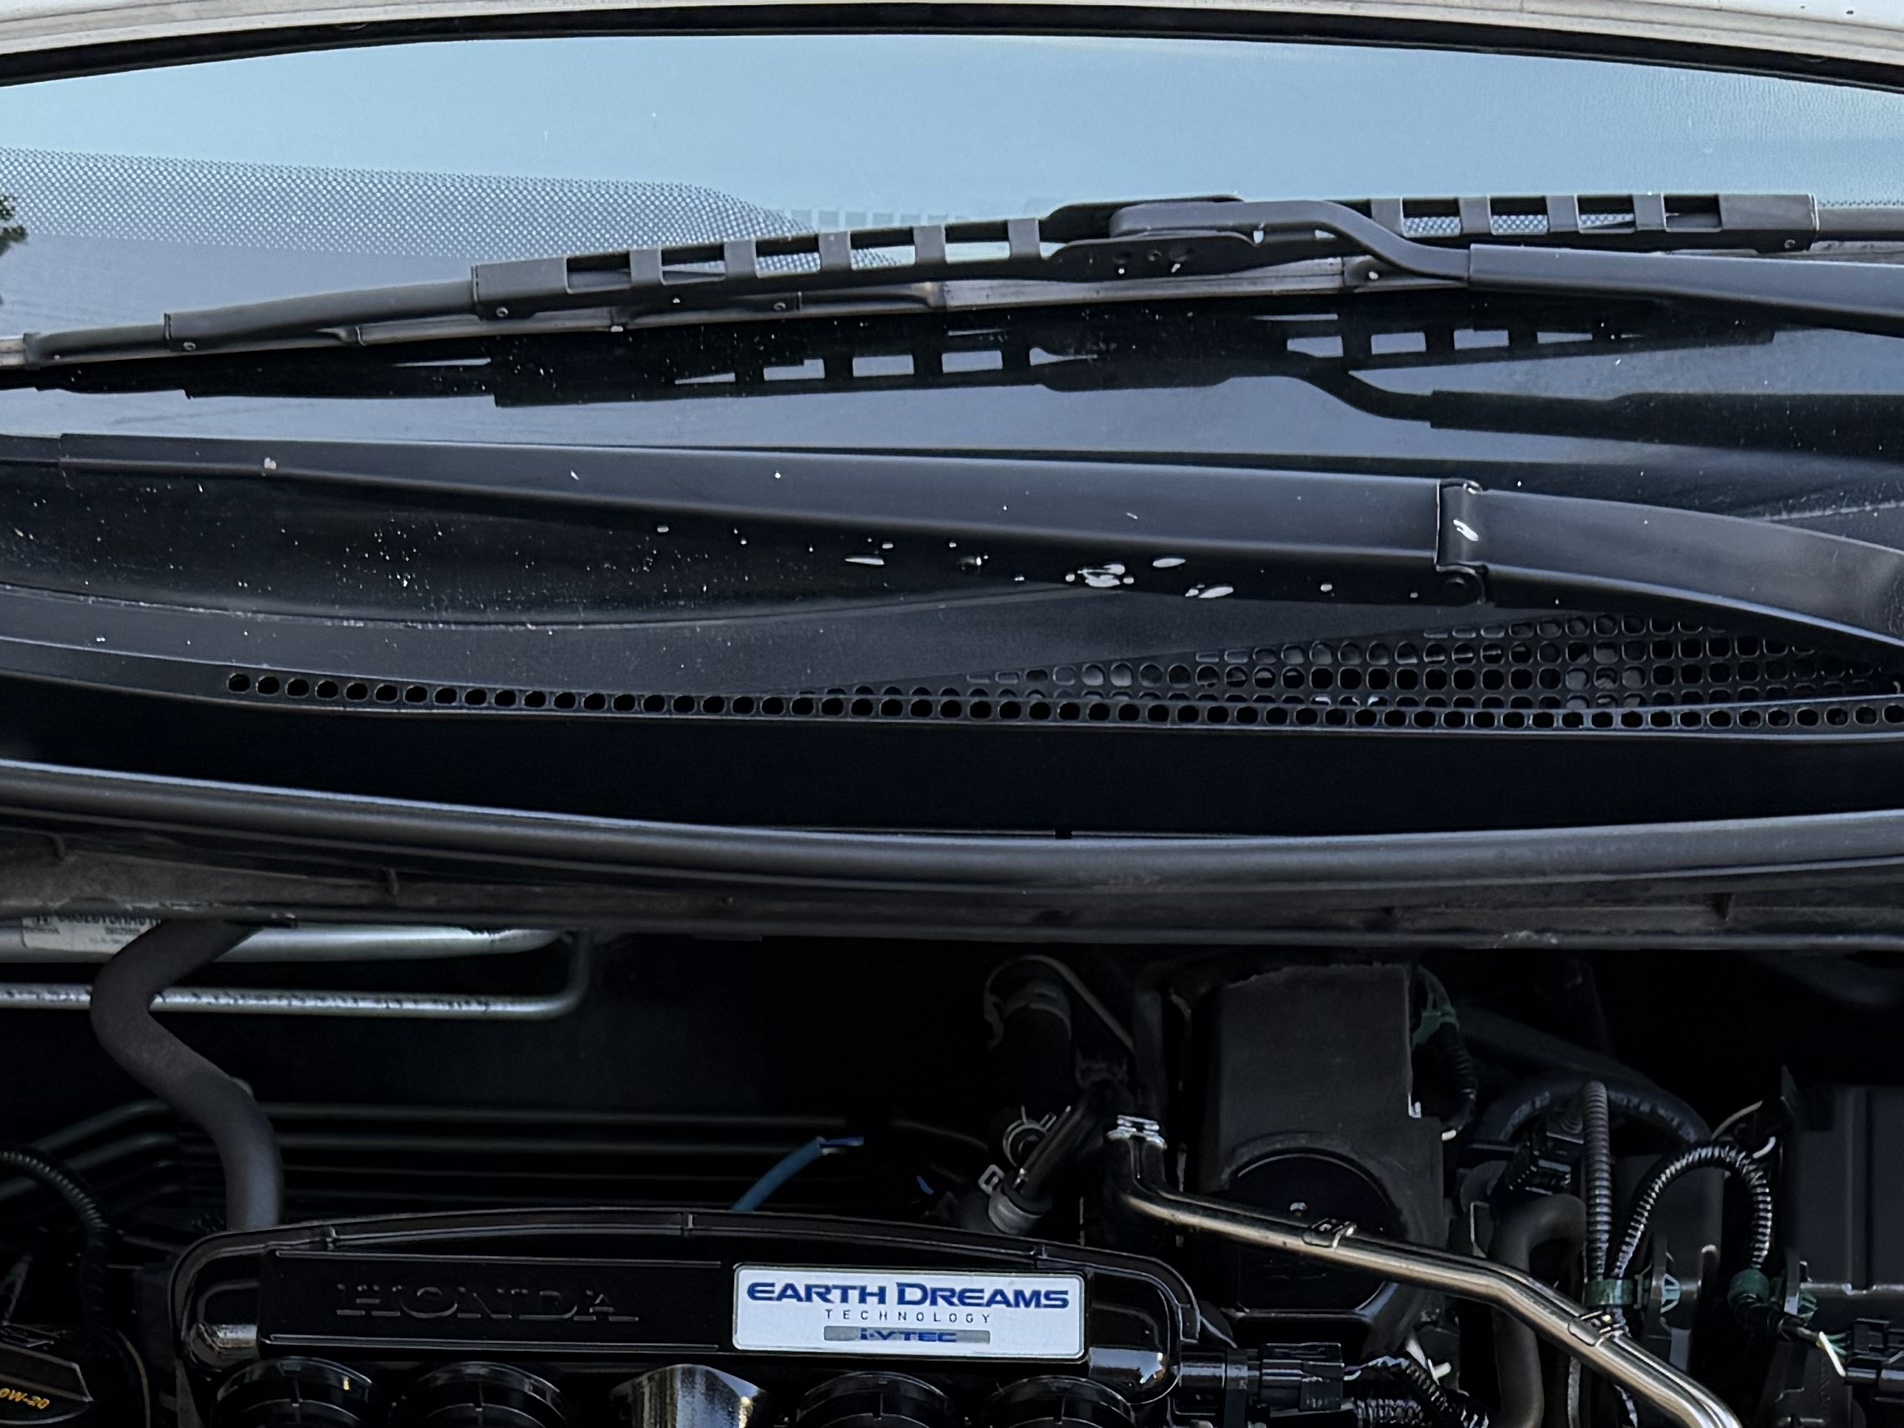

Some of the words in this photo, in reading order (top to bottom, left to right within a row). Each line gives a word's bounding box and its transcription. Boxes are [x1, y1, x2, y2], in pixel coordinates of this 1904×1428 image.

[746, 1281, 888, 1306] EARTH
[895, 1281, 1071, 1310] DREAMS
[824, 1308, 992, 1324] TECHNOLOGY
